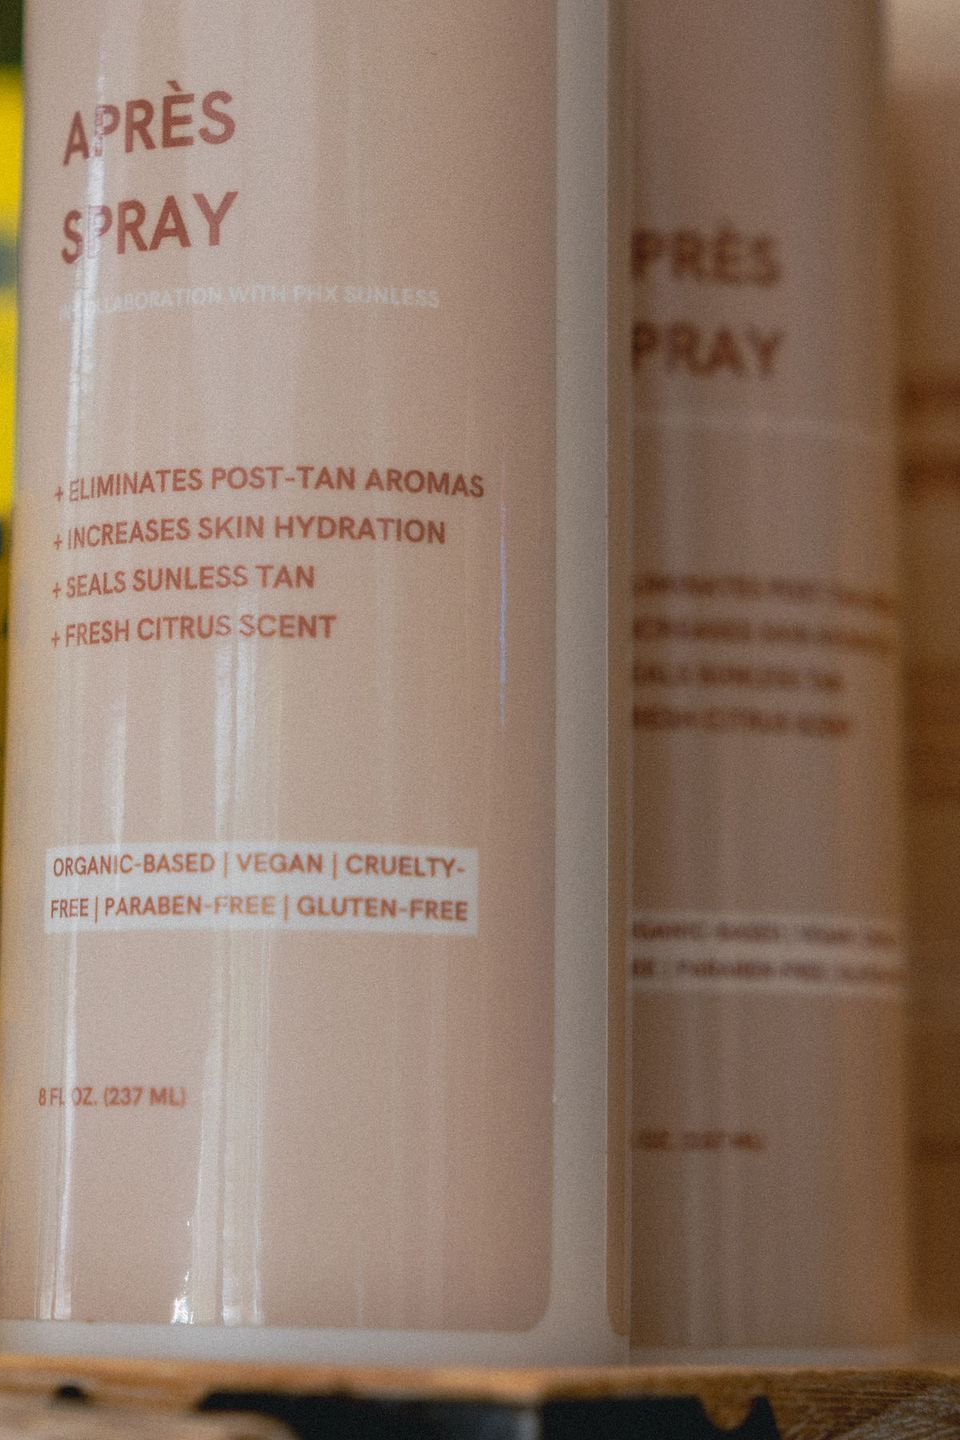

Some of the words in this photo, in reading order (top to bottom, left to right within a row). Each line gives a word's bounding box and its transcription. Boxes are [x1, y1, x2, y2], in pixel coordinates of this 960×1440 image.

[63, 79, 236, 168] APRÈS
[61, 191, 239, 265] SPRAY
[228, 283, 286, 305] WITH
[293, 283, 339, 304] PHX
[344, 285, 439, 309] SUNLESS
[68, 468, 203, 502] ELIMINATES
[211, 466, 356, 491] POST-TAN
[365, 467, 485, 498] AROMAS
[67, 517, 191, 550] INCREASES
[198, 515, 265, 541] SKIN
[274, 516, 446, 545] HYDRATION
[66, 570, 127, 598] SEALS
[132, 565, 248, 592] SUNLESS
[256, 564, 315, 589] TAN
[65, 618, 130, 648] FRESH
[136, 615, 232, 642] CITRUS
[239, 613, 337, 639] SCENT
[52, 852, 216, 878] ORGANIC-BASED
[236, 852, 324, 876] VEGAN
[345, 852, 466, 879] CRUELTY-
[50, 897, 90, 920] FREE
[104, 895, 277, 918] PARABEN-FREE
[296, 895, 469, 922] GLUTEN-FREE
[38, 1086, 48, 1107] 8
[103, 1085, 144, 1108] (237
[149, 1085, 187, 1109] ML)
